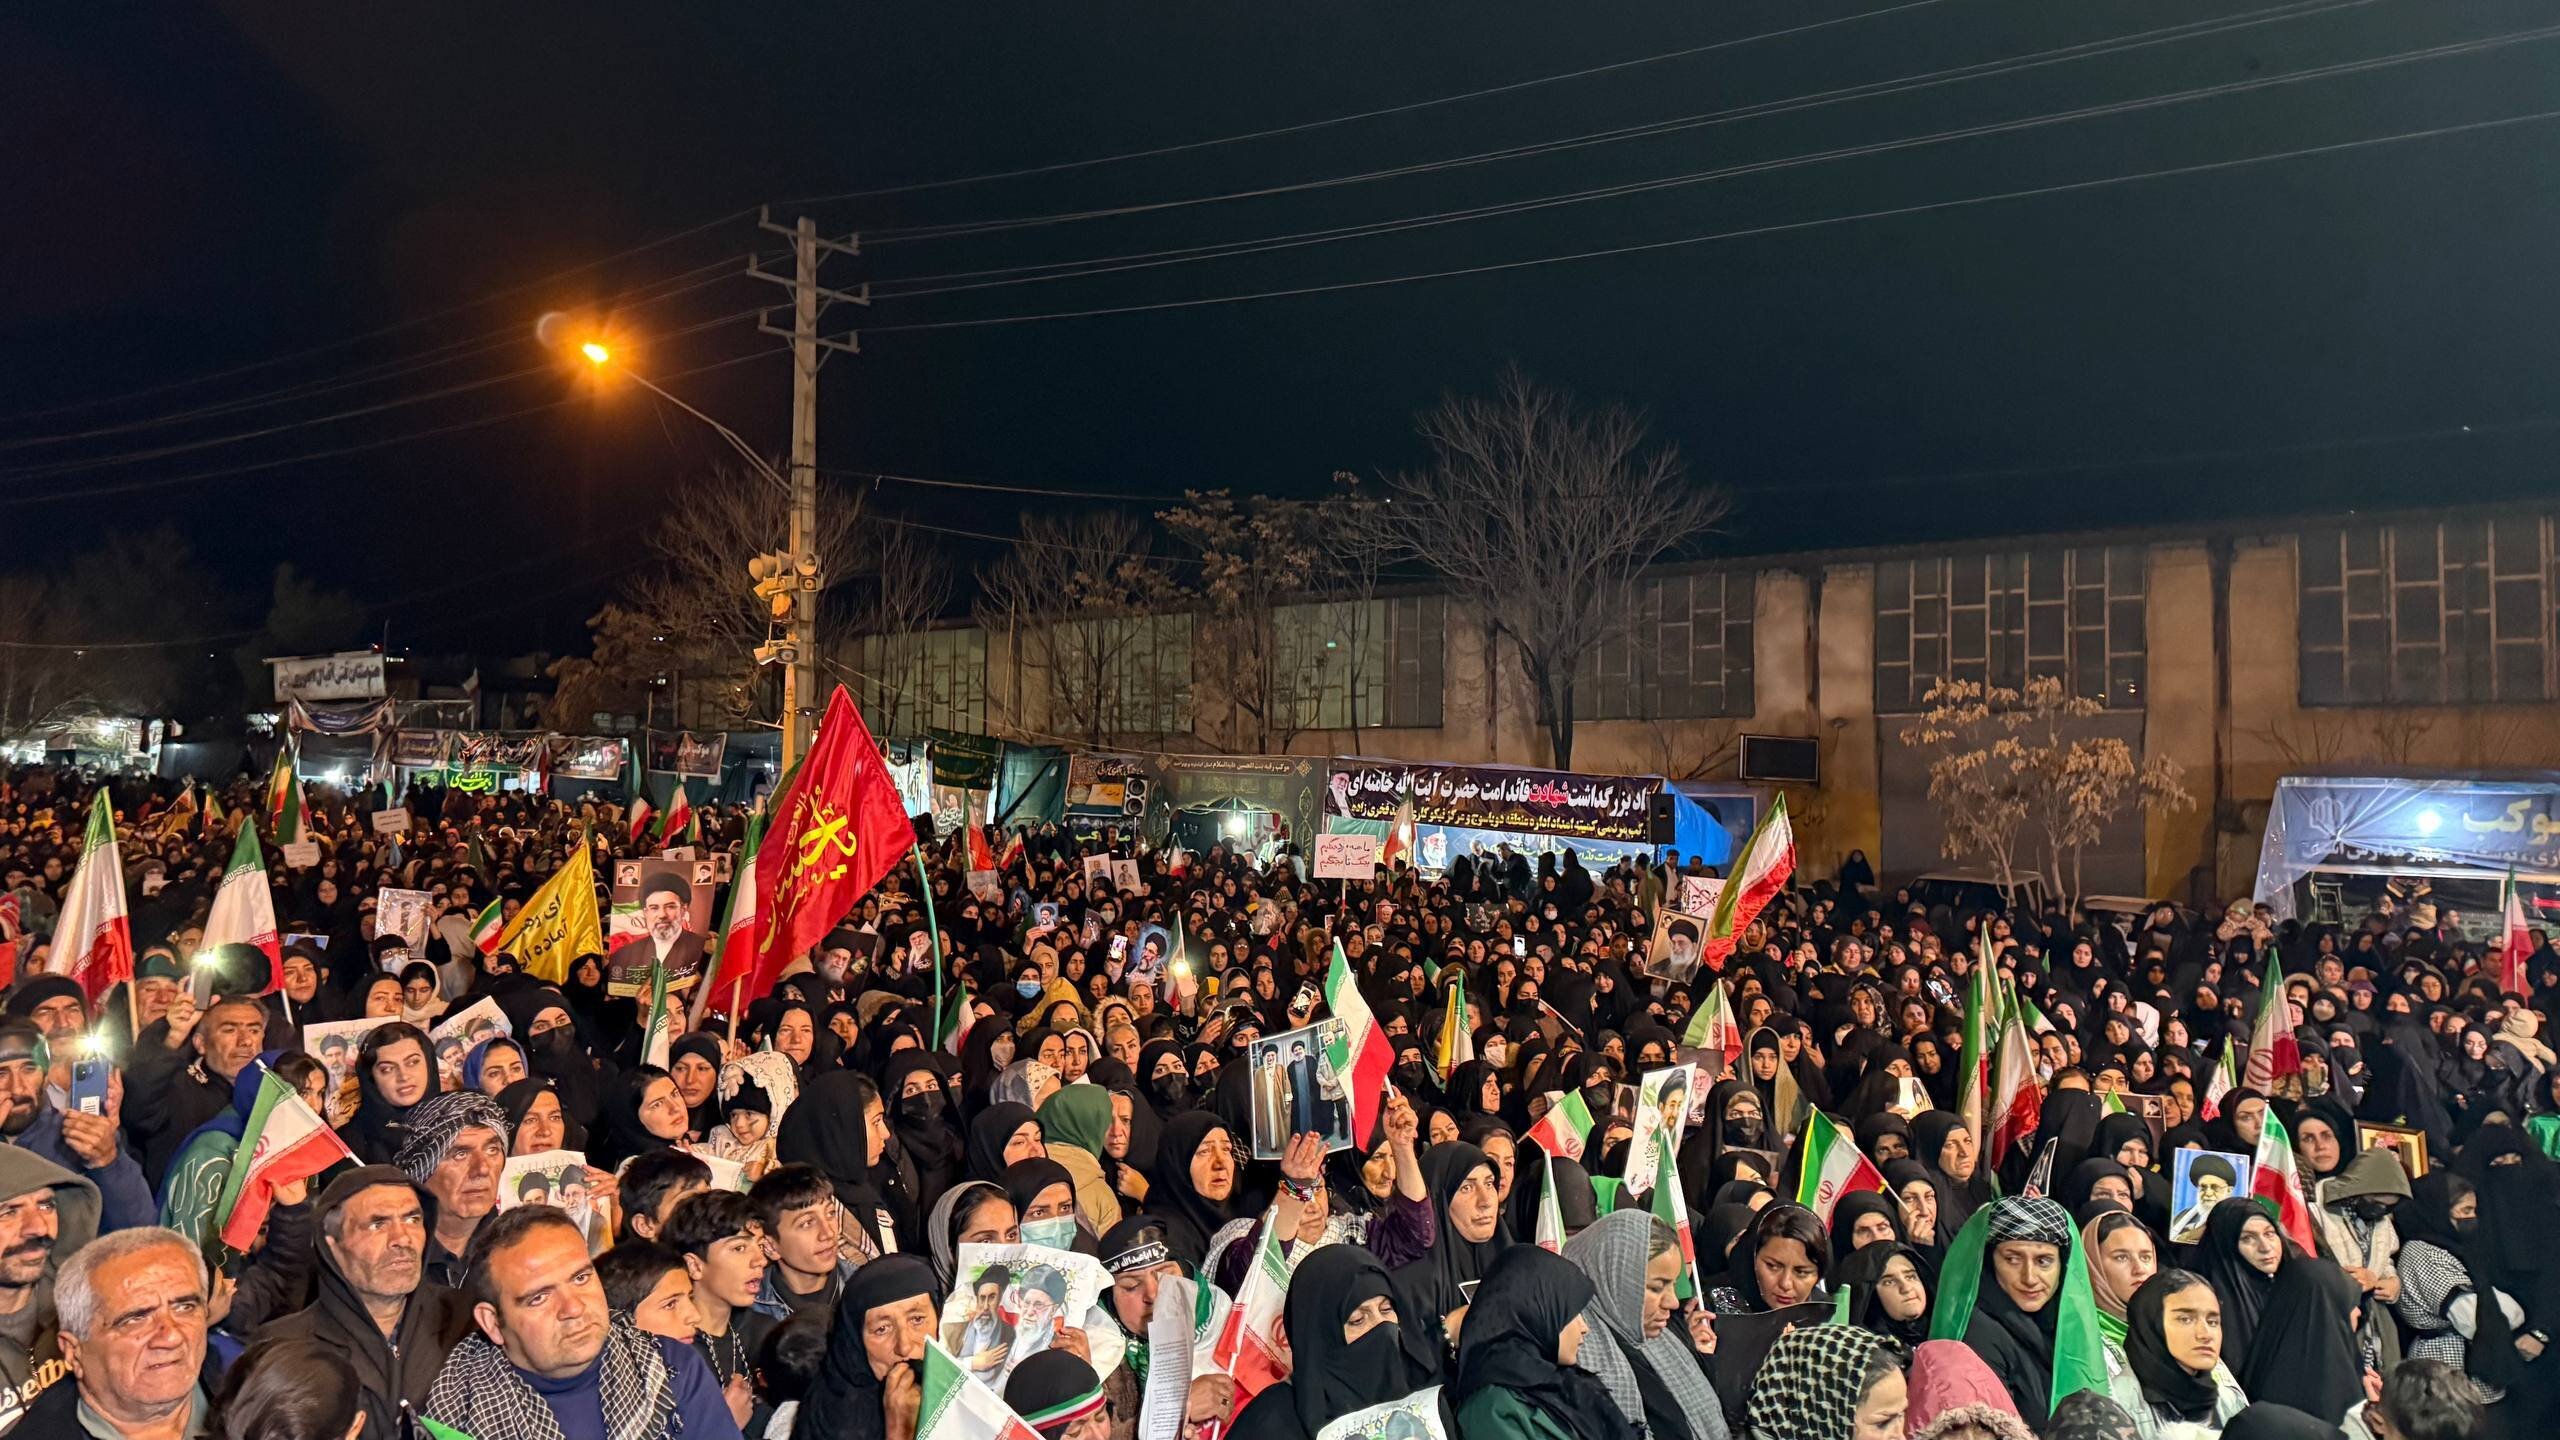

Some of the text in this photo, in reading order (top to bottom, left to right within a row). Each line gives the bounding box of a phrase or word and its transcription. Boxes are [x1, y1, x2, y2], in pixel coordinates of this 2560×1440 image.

[1348, 769, 1364, 796] ای
[1364, 768, 1394, 793] خامنه
[1415, 772, 1441, 801] آیت
[1440, 777, 1479, 805] حضرت
[1480, 778, 1506, 802] امت
[1505, 777, 1530, 802] قائد
[1528, 779, 1569, 808] شهادت
[1567, 784, 1632, 818] بزرگداشت
[1365, 803, 1389, 818] فخری
[1505, 814, 1529, 827] منطقه
[1550, 816, 1574, 829] امداد
[1363, 841, 1371, 851] ما
[533, 916, 568, 956] آماده
